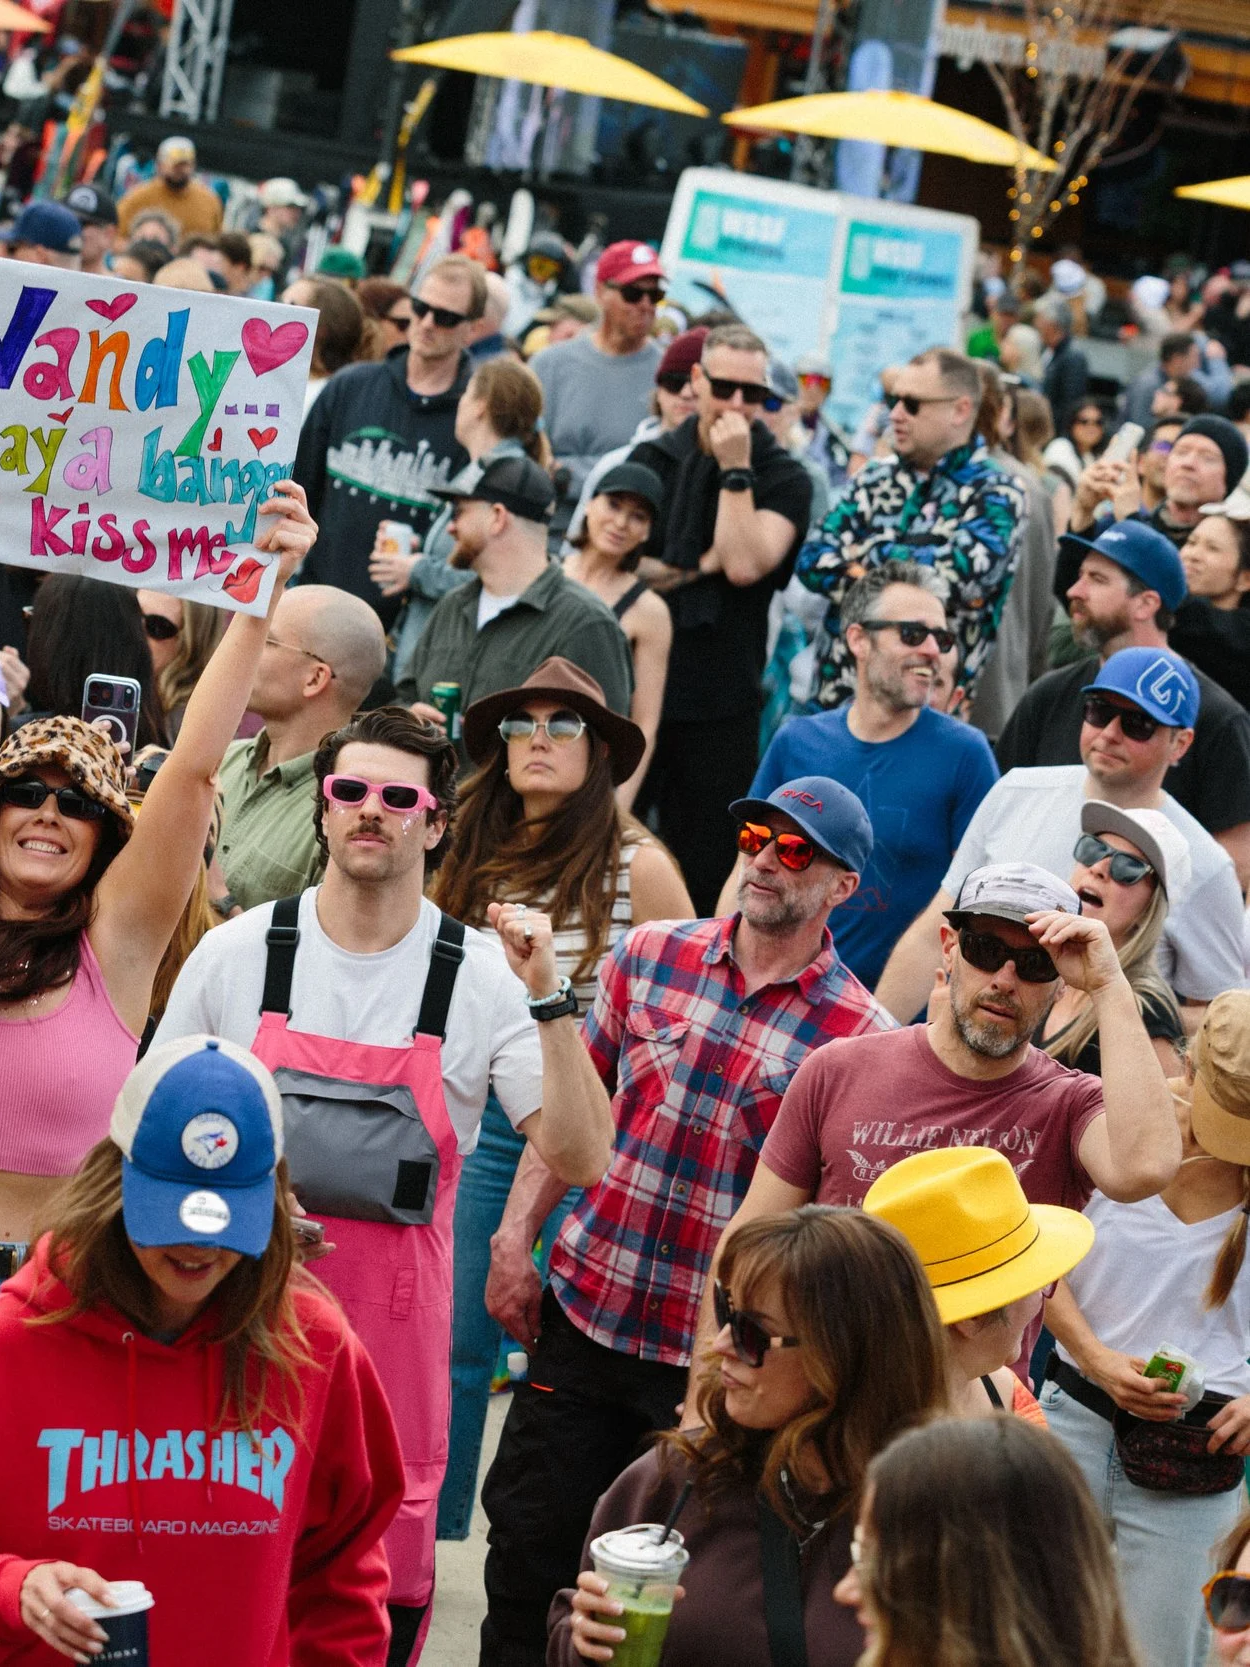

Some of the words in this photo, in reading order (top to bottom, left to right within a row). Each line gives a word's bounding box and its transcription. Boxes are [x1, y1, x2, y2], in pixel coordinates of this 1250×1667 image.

[63, 426, 113, 496] a
[167, 525, 239, 581] me
[852, 1121, 944, 1149] WILLIE
[37, 1426, 296, 1515] THRASHER
[190, 1518, 280, 1536] MAGAZINE
